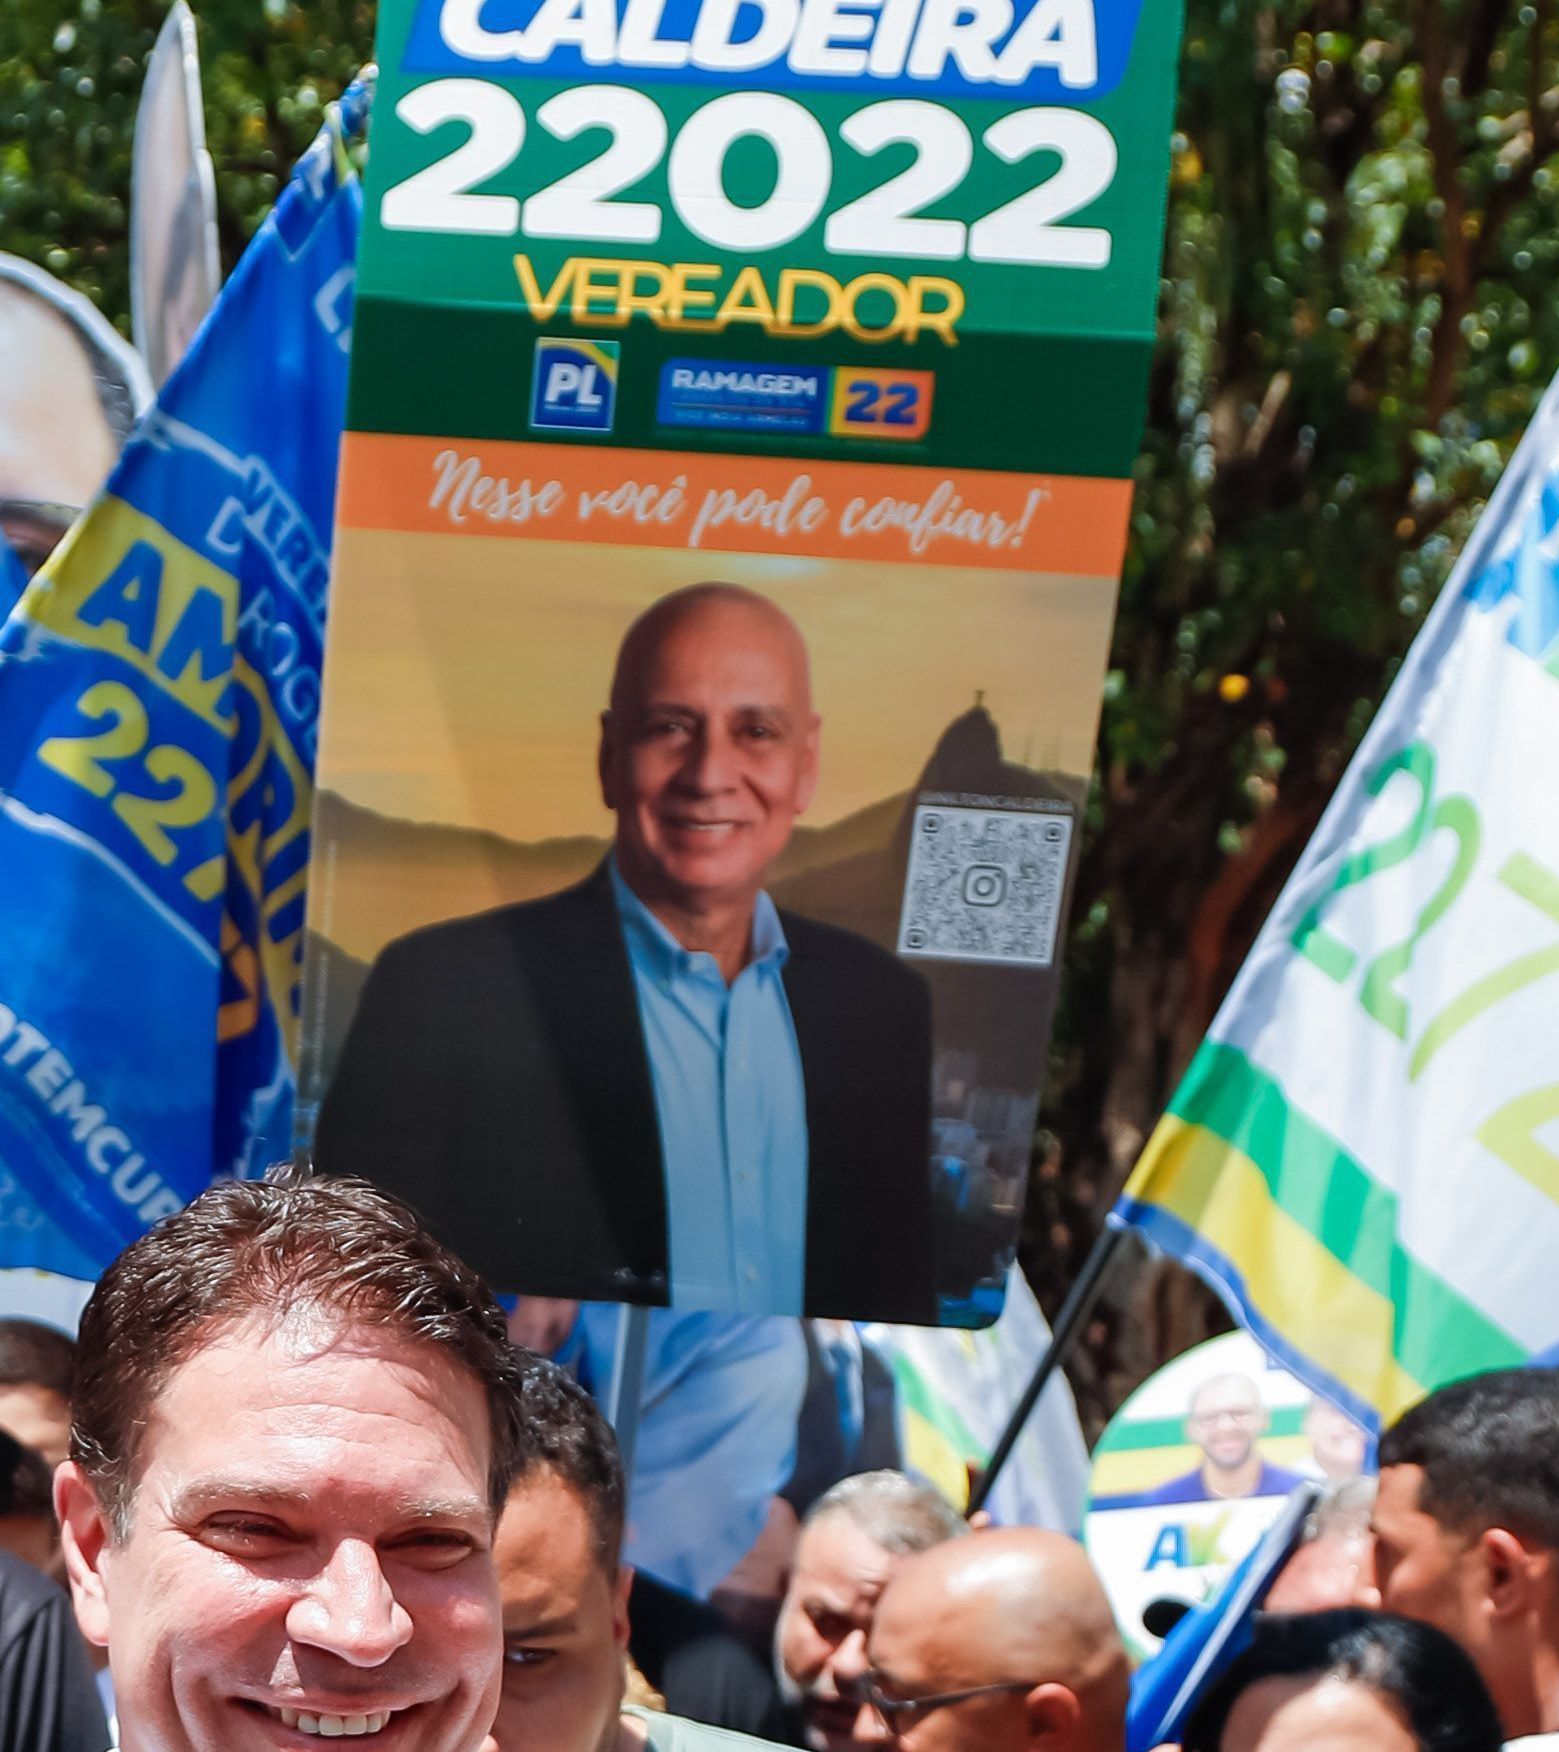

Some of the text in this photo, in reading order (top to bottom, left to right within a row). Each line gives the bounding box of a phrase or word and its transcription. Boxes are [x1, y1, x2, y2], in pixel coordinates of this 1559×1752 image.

[440, 0, 1099, 90] CALDEIRA
[379, 76, 1120, 271] 22022
[512, 252, 966, 347] VEREADOR
[543, 361, 605, 406] PL
[672, 368, 818, 397] RAMAGEM
[844, 379, 920, 426] 22
[428, 449, 1044, 554] Nesse você pode confiar!
